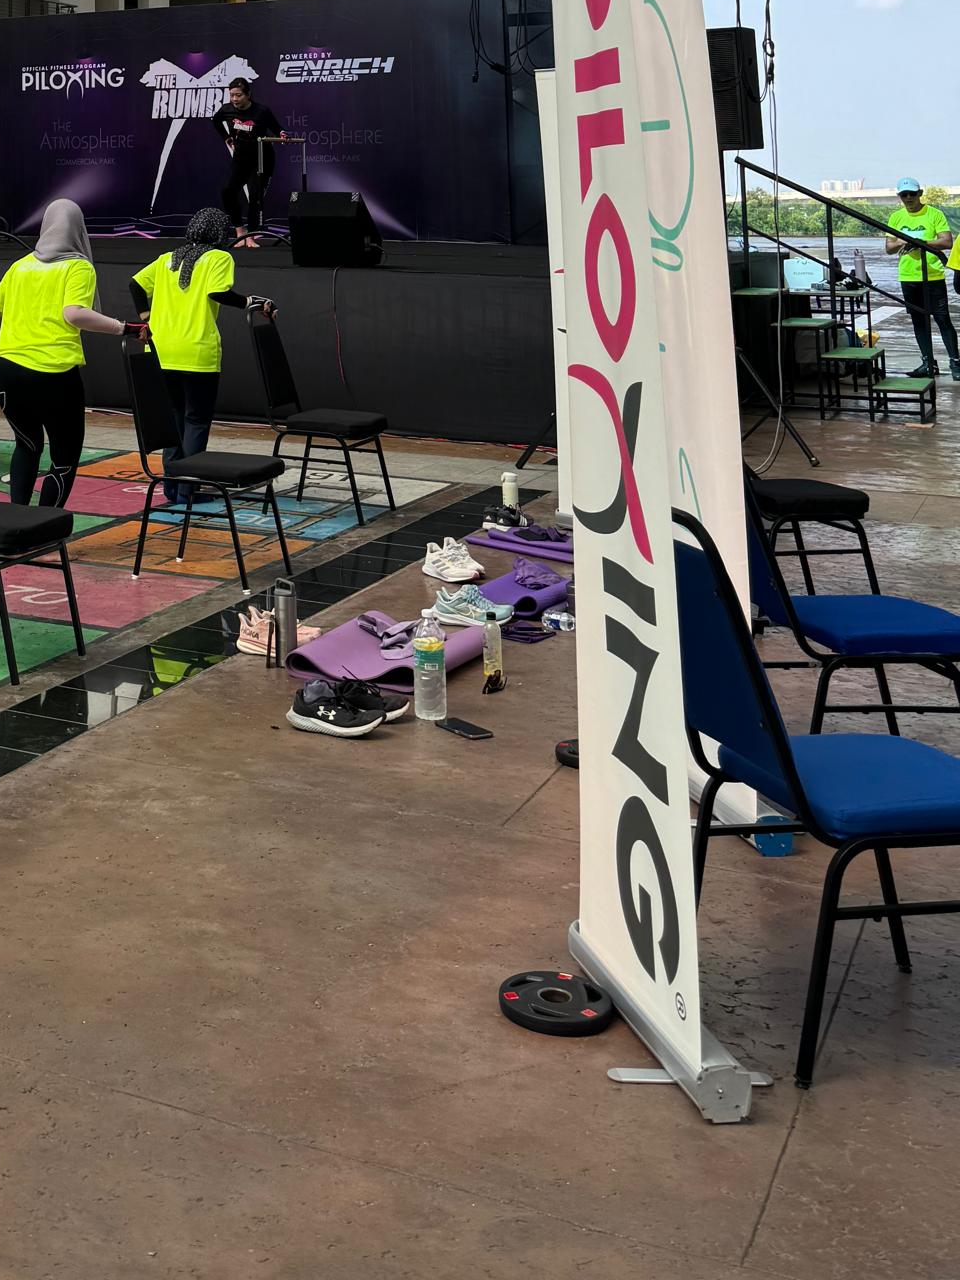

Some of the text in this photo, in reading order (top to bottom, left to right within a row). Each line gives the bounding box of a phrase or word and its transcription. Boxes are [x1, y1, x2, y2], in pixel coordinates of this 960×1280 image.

[280, 51, 332, 60] POWERED BY
[275, 56, 395, 83] ENRICH
[21, 67, 125, 100] PILOXING
[155, 74, 176, 89] THE
[300, 74, 354, 83] FITNESS
[52, 118, 73, 133] THE
[285, 109, 309, 127] THE
[240, 625, 260, 641] HOKA
